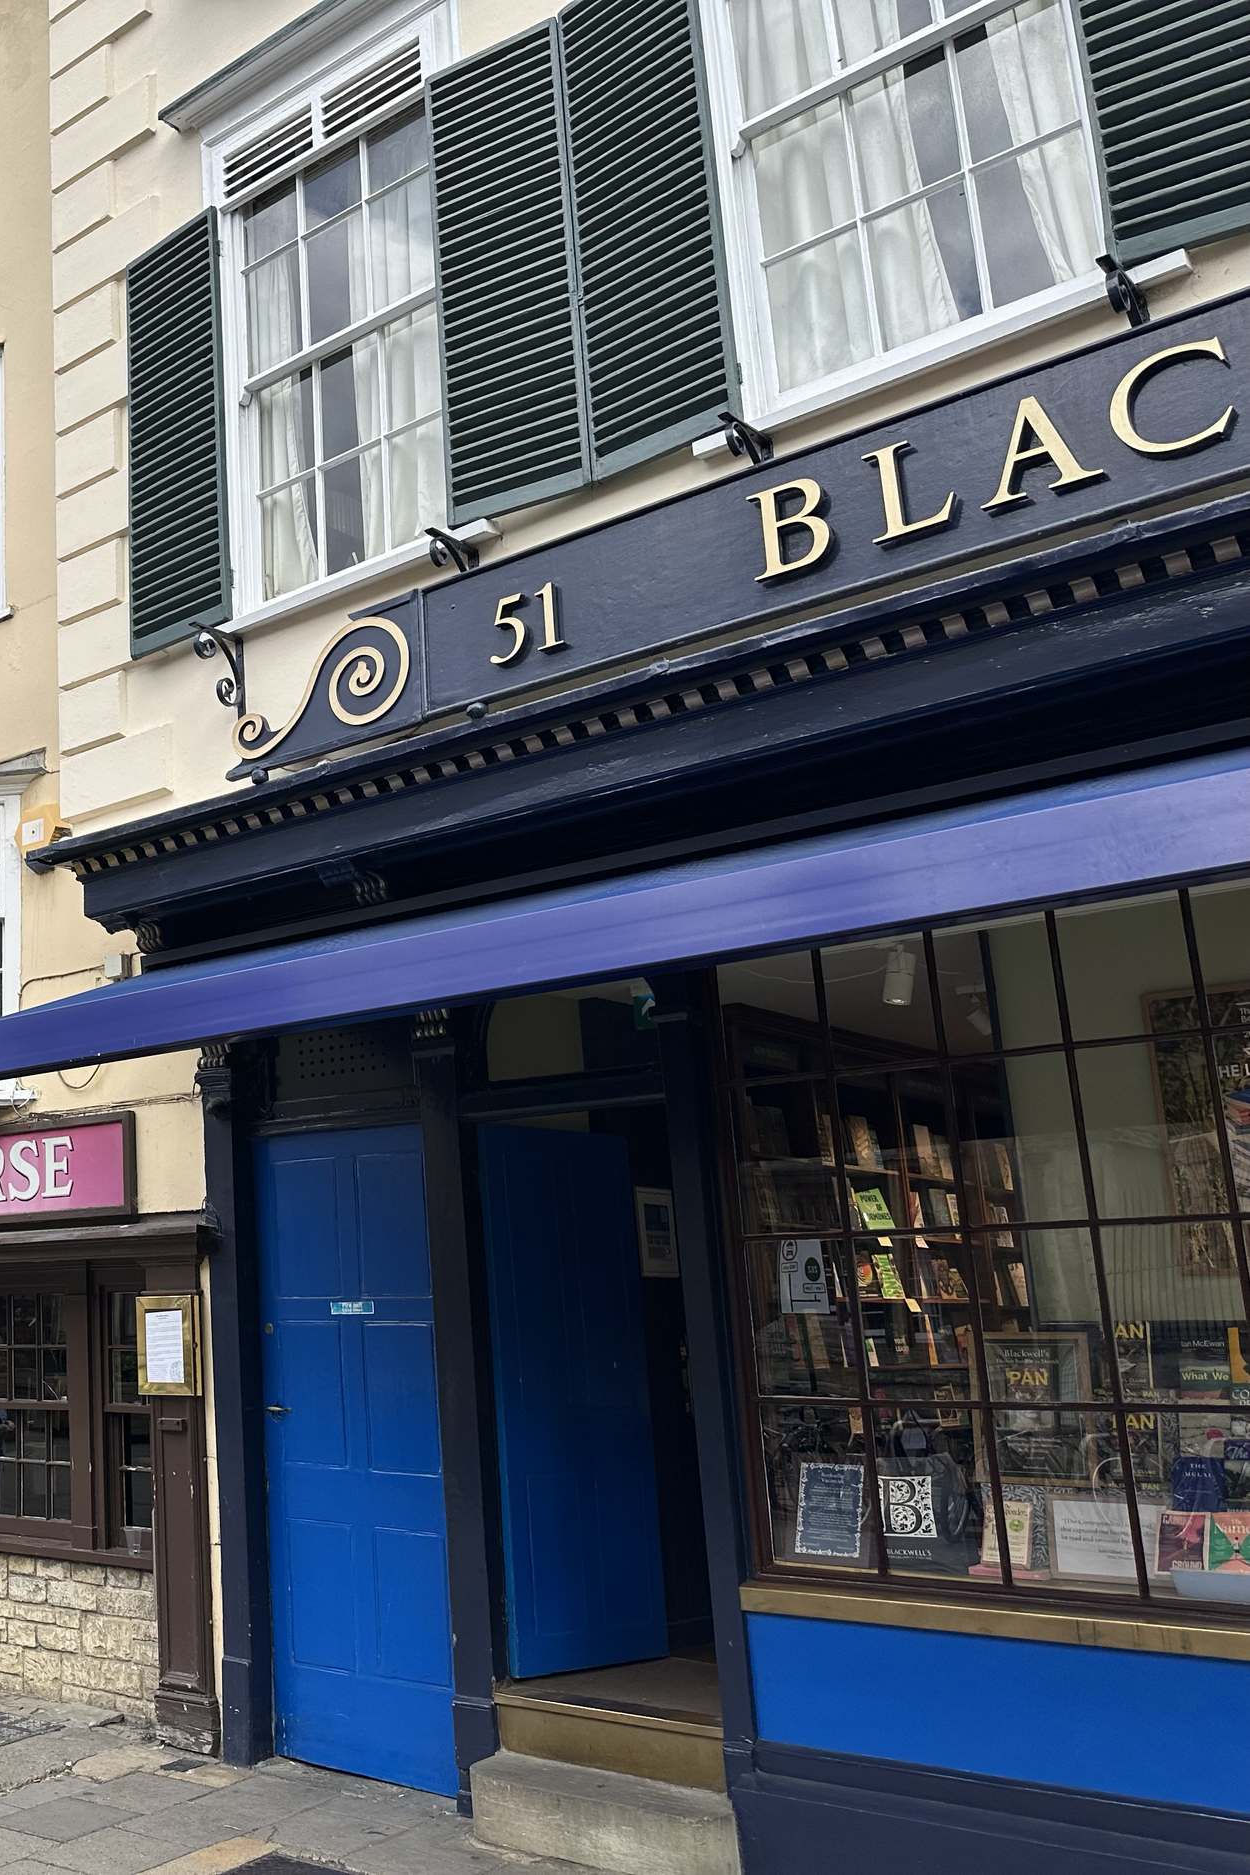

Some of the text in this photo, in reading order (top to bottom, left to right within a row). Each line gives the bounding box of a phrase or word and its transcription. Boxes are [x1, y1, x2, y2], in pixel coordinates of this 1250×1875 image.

[490, 336, 1234, 665] 51 BLAC
[859, 1194, 879, 1203] POWER
[865, 1212, 891, 1221] ORMONES
[1115, 1321, 1144, 1339] AN
[1192, 1340, 1225, 1348] McEwan
[1004, 1349, 1050, 1358] Blackwell's
[1010, 1371, 1048, 1386] PAN
[1181, 1371, 1229, 1381] What We
[886, 1548, 932, 1557] BLACKWELL'S
[1172, 1559, 1202, 1570] GROUND
